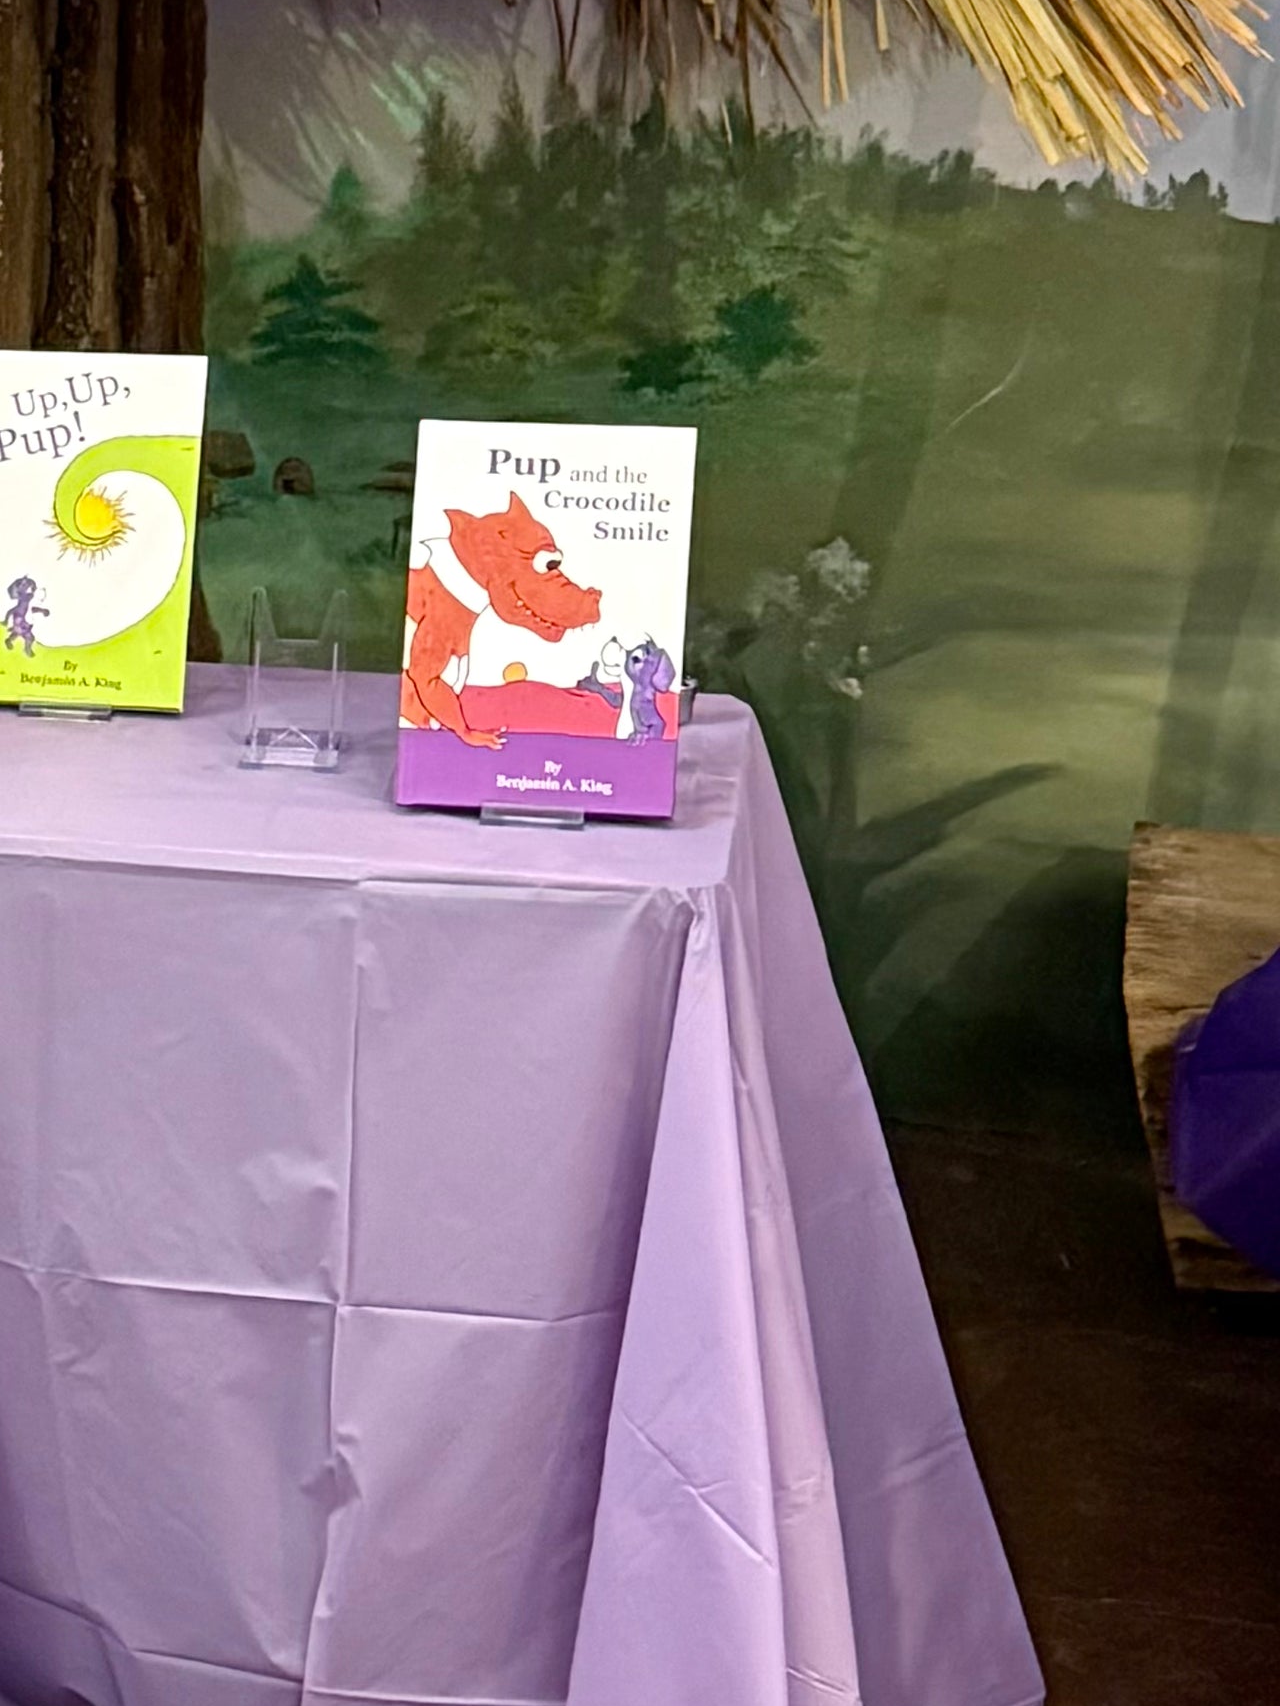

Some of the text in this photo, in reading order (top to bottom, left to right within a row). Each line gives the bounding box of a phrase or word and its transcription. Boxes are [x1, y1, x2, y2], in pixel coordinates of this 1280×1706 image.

[486, 448, 647, 484] Pup and the
[543, 489, 671, 513] Crocodile
[593, 520, 669, 542] Smile
[63, 660, 78, 674] By
[545, 760, 562, 776] By
